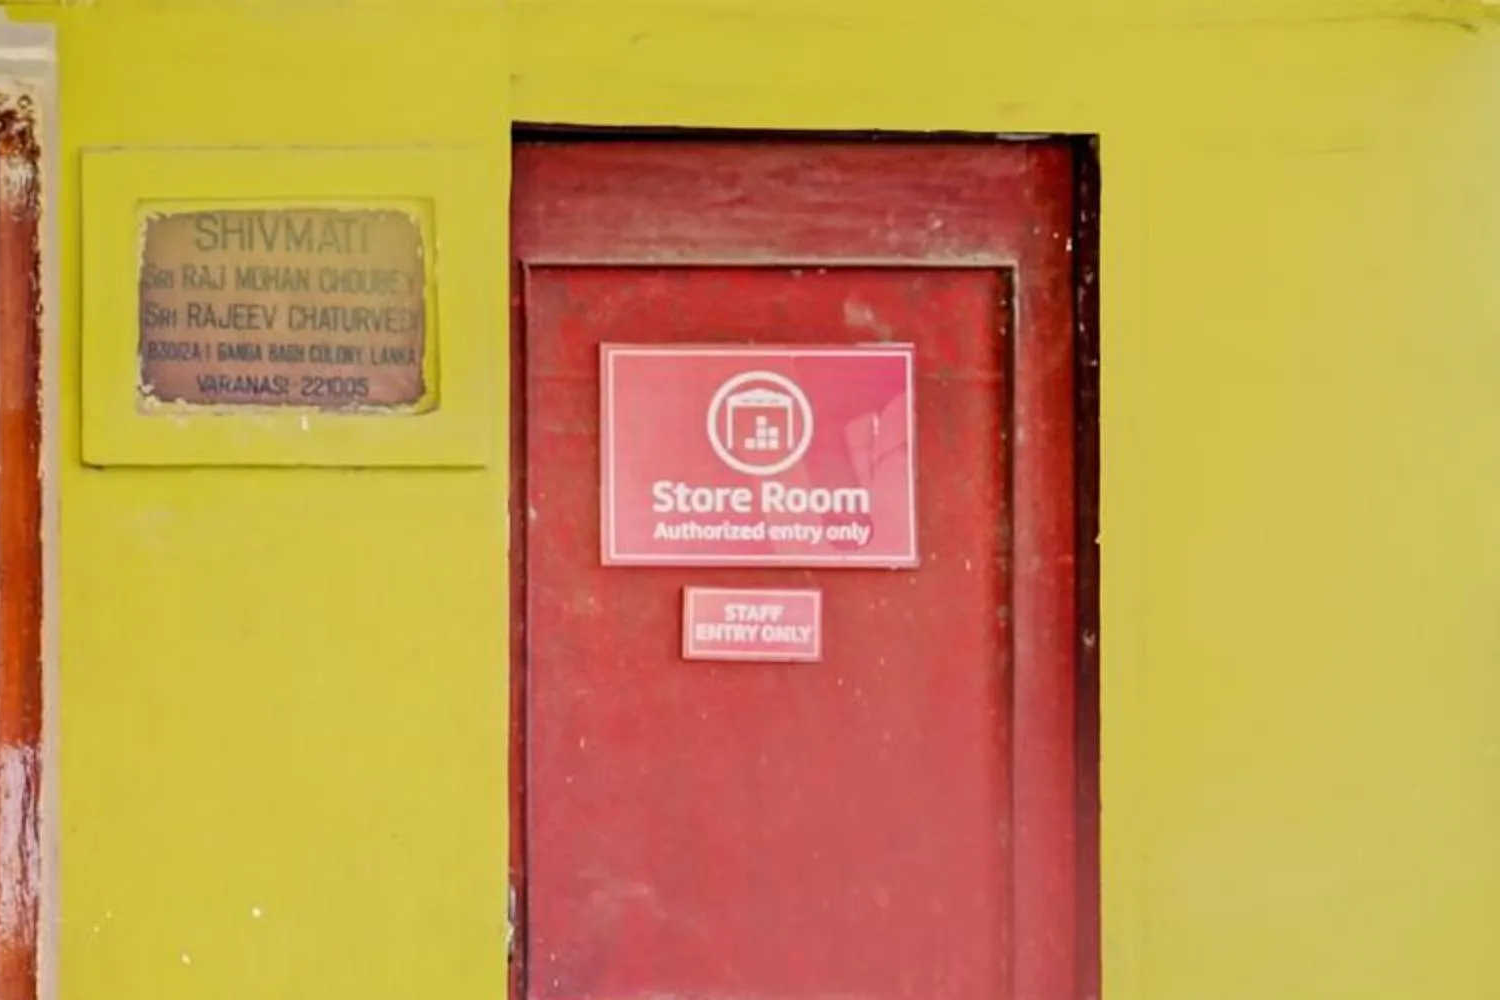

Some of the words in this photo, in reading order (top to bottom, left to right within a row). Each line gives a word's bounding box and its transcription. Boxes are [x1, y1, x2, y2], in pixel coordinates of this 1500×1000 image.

[194, 213, 369, 254] SHIVMATI
[181, 264, 226, 290] RAJ
[235, 265, 310, 293] MOHAN
[187, 302, 277, 330] RAJEEV
[652, 480, 752, 513] Store
[760, 481, 870, 514] Room
[653, 521, 765, 541] Authorized
[768, 524, 821, 544] entry
[826, 524, 870, 545] only
[724, 603, 784, 622] STAFF
[695, 623, 759, 642] ENTRY
[761, 625, 812, 643] ONLY
